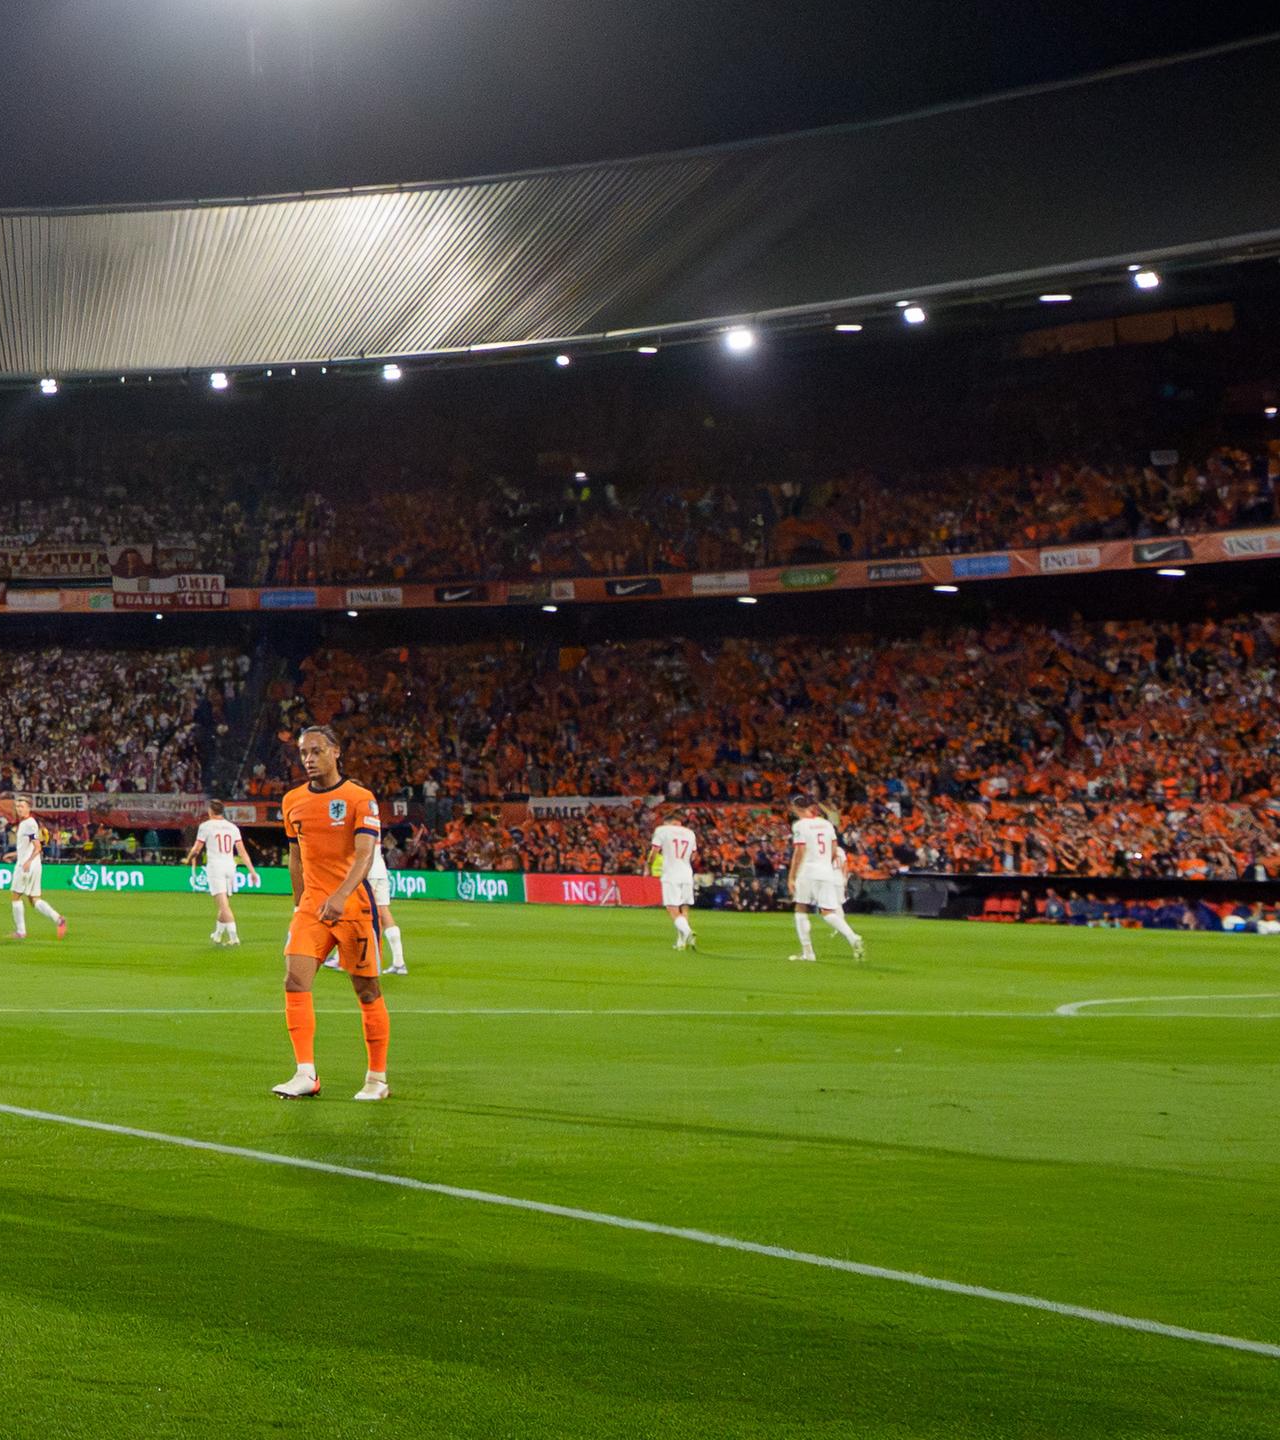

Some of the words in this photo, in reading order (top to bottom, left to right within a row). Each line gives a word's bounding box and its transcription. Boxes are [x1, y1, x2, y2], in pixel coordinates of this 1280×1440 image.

[215, 833, 232, 854] 10
[672, 837, 689, 860] 17
[817, 833, 826, 855] 5
[102, 864, 144, 891] kpn
[233, 871, 261, 893] pn
[395, 871, 427, 898] kpn
[476, 873, 509, 901] kpn
[563, 880, 598, 902] ING
[356, 938, 369, 962] 7
